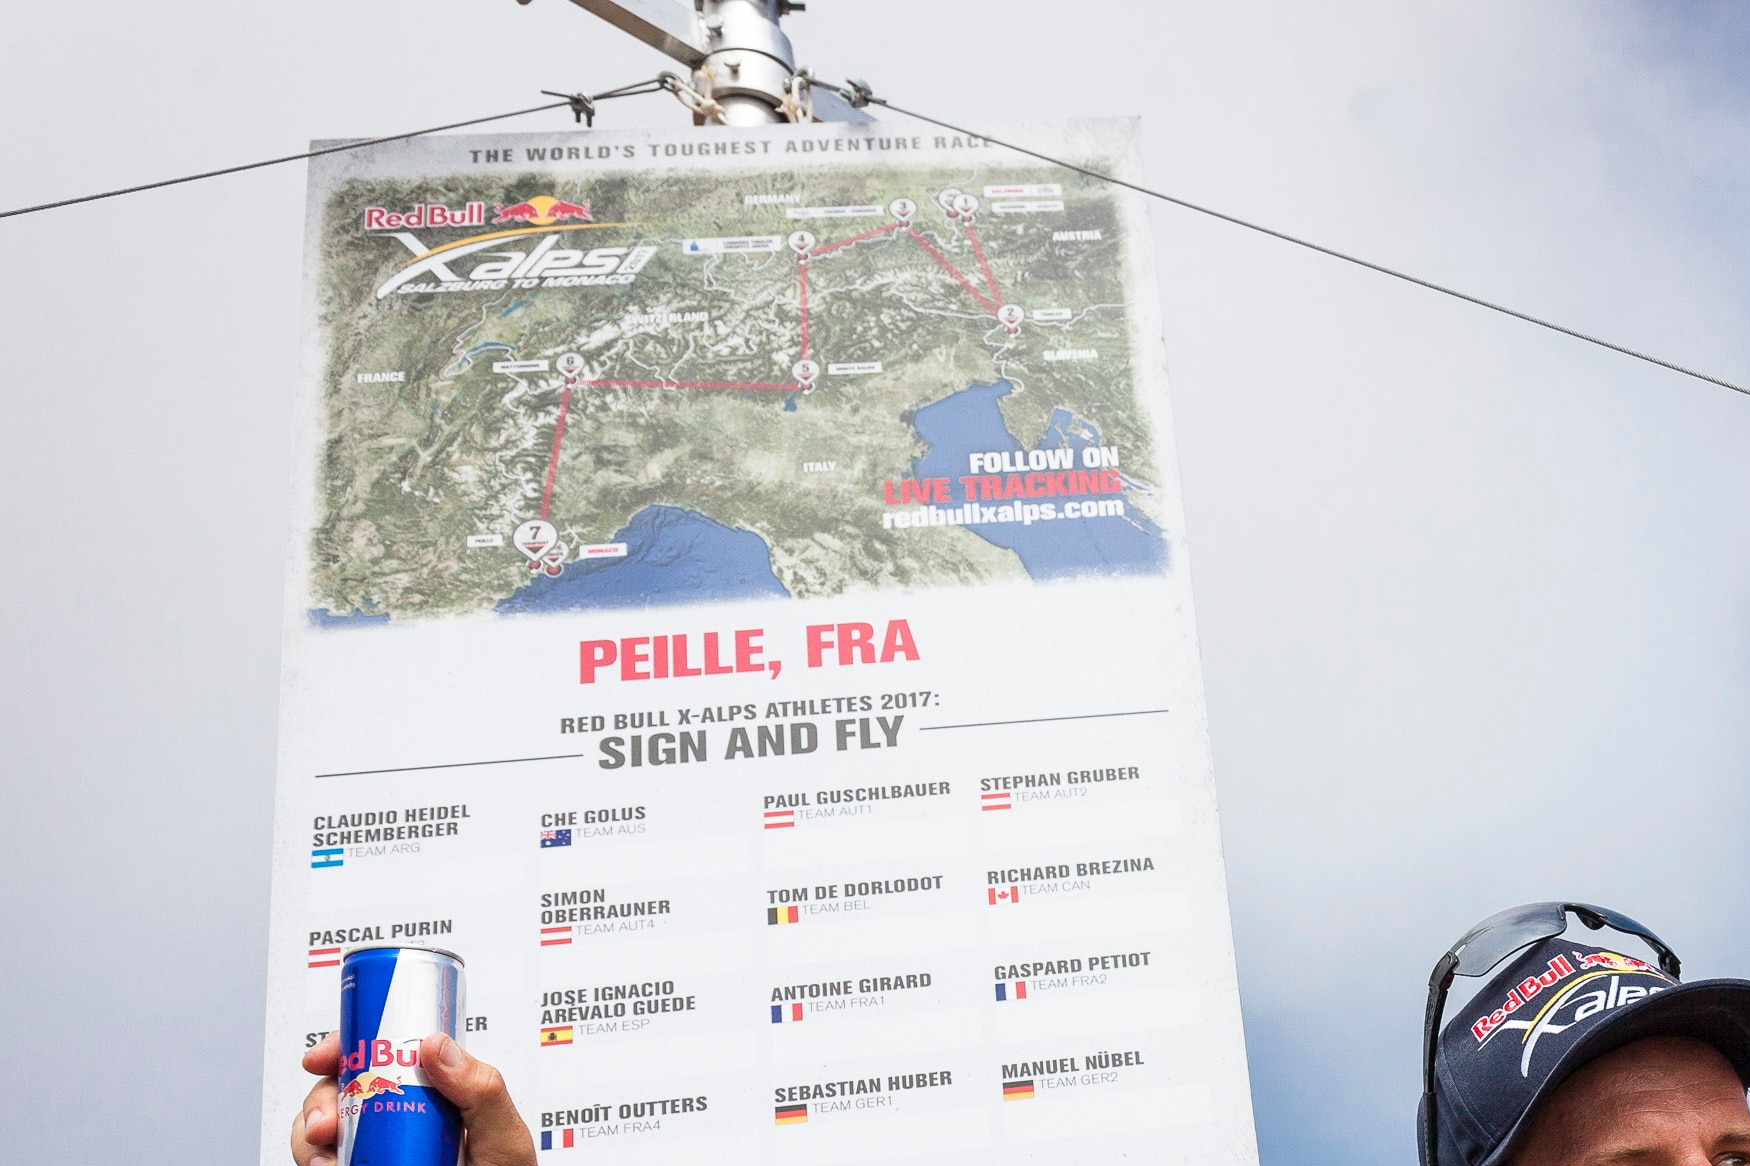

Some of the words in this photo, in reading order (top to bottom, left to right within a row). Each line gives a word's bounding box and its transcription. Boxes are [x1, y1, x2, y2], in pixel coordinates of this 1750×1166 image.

[470, 149, 512, 163] THE
[527, 143, 636, 162] WORLD'S
[648, 140, 772, 157] TOUGHEST
[786, 136, 922, 153] ADVENTURE
[933, 135, 993, 149] RACE
[365, 204, 423, 230] Red
[427, 202, 485, 227] Bull
[1053, 229, 1102, 241] AUSTRIA
[397, 280, 508, 294] SALZBURG
[513, 278, 538, 288] TO
[542, 274, 635, 287] MONACO
[625, 311, 709, 324] SWITZERLAND
[1043, 348, 1098, 361] SLOVENIA
[357, 371, 406, 384] FRANCE
[803, 461, 836, 473] ITALY
[970, 448, 1073, 474] FOLLOW
[1082, 446, 1119, 467] ON
[884, 477, 951, 505] LIVE
[960, 469, 1121, 500] TRACKING
[882, 498, 1124, 530] redbullxalps.com
[529, 526, 541, 540] 7
[580, 629, 782, 685] PEILLE,
[806, 619, 920, 668] FRA
[560, 717, 604, 734] RED
[614, 712, 669, 731] BULL
[678, 705, 757, 726] X-ALPS
[766, 695, 872, 720] ATHLETES
[881, 691, 940, 710] 2017:
[598, 730, 708, 770] SIGN
[725, 722, 818, 760] AND
[836, 715, 904, 750] FLY
[980, 772, 1062, 792] STEPHAN
[1067, 766, 1140, 785] GRUBER
[763, 793, 810, 811] PAUL
[817, 781, 951, 806] GUSCHLBAUER
[314, 810, 397, 831] CLAUDIO
[405, 804, 470, 823] HEIDEL
[541, 811, 577, 828] CHE
[583, 806, 646, 823] GOLUS
[313, 821, 458, 847] SCHEMBERGER
[987, 865, 1070, 885] RICHARD
[1076, 857, 1155, 877] BREZINA
[541, 889, 605, 908] SIMON
[767, 888, 809, 905] TOM
[815, 885, 838, 901] DE
[844, 875, 944, 899] DORLODOT
[1022, 882, 1058, 896] TEAM
[1061, 879, 1091, 893] CAN
[541, 900, 670, 925] OBERRAUNER
[309, 925, 384, 946] PASCAL
[391, 919, 452, 938] PURIN
[576, 923, 614, 936] TEAM
[617, 920, 655, 932] AUT4
[994, 959, 1083, 981] GASPARD
[1088, 952, 1151, 971] PETIOT
[541, 989, 587, 1007] JOSE
[594, 980, 674, 1001] IGNACIO
[771, 981, 854, 1002] ANTOINE
[859, 973, 932, 994] GIRARD
[1030, 978, 1067, 992] TEAM
[1071, 974, 1108, 988] FRA2
[541, 1002, 627, 1025] ARÉVALO
[633, 996, 696, 1016] GUEDE
[1471, 990, 1521, 1043] Red
[1515, 954, 1576, 1004] Bull
[578, 1022, 616, 1036] TEAM
[619, 1019, 651, 1031] ESP
[1001, 1058, 1080, 1080] MANUEL
[1085, 1051, 1144, 1070] NÜBEL
[775, 1079, 881, 1103] SEBASTIAN
[887, 1071, 953, 1092] HUBER
[1038, 1077, 1074, 1089] TEAM
[1081, 1072, 1119, 1085] GER2
[374, 1101, 427, 1114] DRINK
[541, 1103, 611, 1130] BENOÎT
[619, 1096, 708, 1121] OUTTERS
[813, 1100, 851, 1114] TEAM
[855, 1097, 894, 1110] GER1
[579, 1124, 619, 1139] TEAM
[624, 1120, 661, 1134] FRA4
